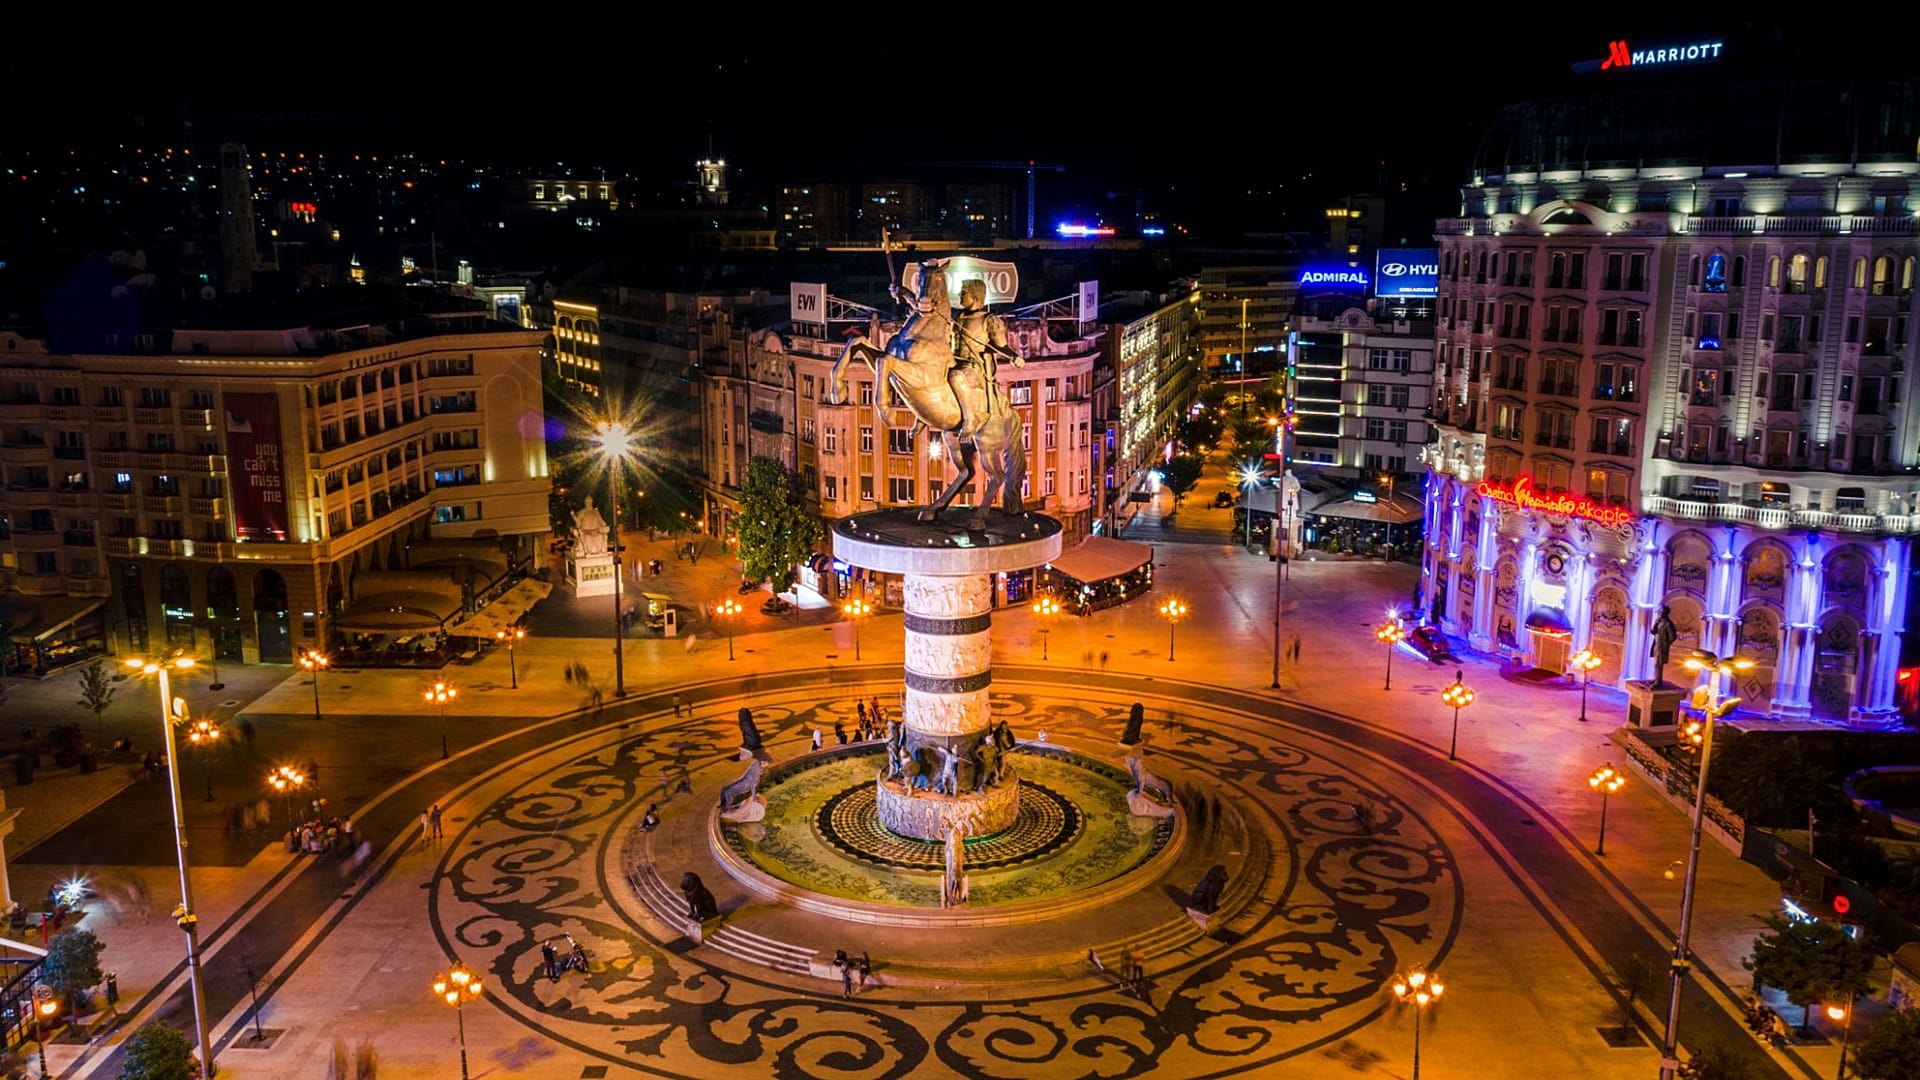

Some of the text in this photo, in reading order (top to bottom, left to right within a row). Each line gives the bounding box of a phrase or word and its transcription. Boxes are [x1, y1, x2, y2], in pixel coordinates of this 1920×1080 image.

[1631, 43, 1723, 66] MARRIOTT
[1301, 271, 1368, 284] ADMIRAL
[797, 293, 816, 311] EVN
[255, 443, 278, 460] you
[243, 456, 280, 472] can't
[250, 472, 281, 488] miss
[263, 490, 283, 503] me
[1476, 476, 1631, 527] Casino Flamingo Skopje
